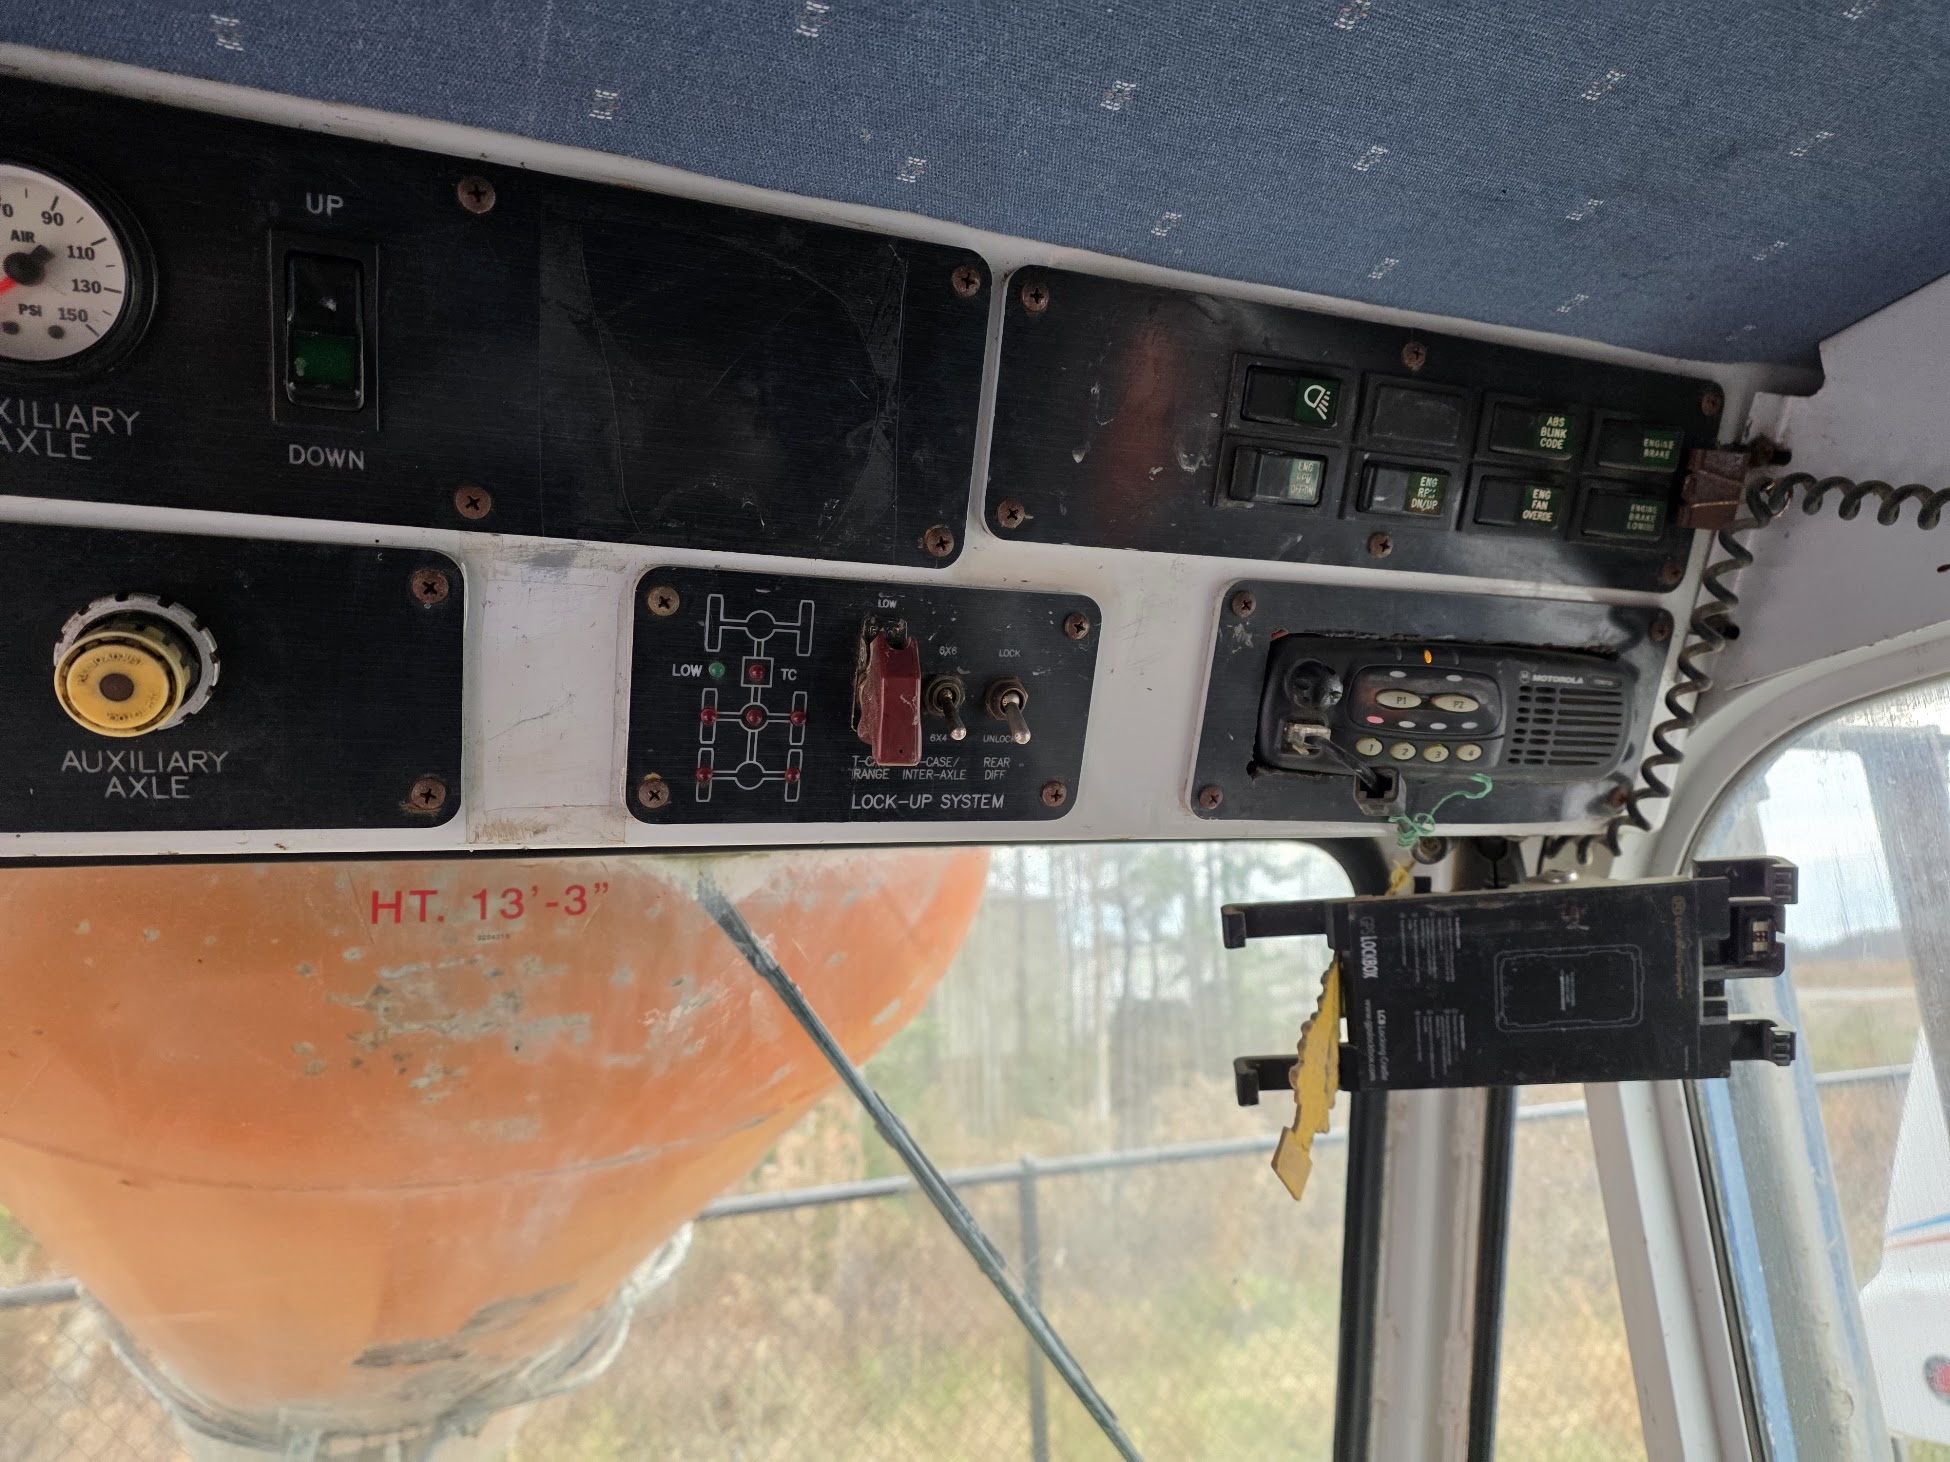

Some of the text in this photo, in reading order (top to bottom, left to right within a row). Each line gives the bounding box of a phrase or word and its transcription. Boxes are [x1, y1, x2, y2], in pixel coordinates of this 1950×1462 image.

[0, 202, 14, 218] 0
[305, 192, 344, 216] UP
[41, 210, 64, 227] 90
[10, 229, 36, 244] AIR
[67, 245, 95, 261] 110
[72, 279, 102, 294] 130
[18, 303, 43, 317] PSI
[58, 307, 88, 323] 150
[1546, 416, 1565, 427] ABS
[1540, 427, 1567, 439] BLINK
[1539, 438, 1564, 450] CODE
[1643, 437, 1675, 450] ENGINE
[288, 444, 365, 471] DOWN
[1643, 448, 1671, 460] BRAKE
[1298, 461, 1314, 472] ENG
[1420, 476, 1438, 488] ENG
[1532, 488, 1552, 500] ENG
[1531, 499, 1549, 511] FAN
[877, 599, 898, 609] LOW
[939, 646, 958, 656] 6X6
[999, 648, 1021, 658] LOCK
[672, 663, 703, 678] LOW
[781, 667, 798, 681] TC
[1531, 674, 1584, 685] MOTOROLA
[1396, 695, 1465, 710] P1 P2
[929, 733, 948, 743] 6X4
[1402, 748, 1409, 756] 2
[1435, 750, 1442, 759] 3
[1467, 748, 1475, 757] 4
[61, 750, 229, 773] AUXILIARY
[852, 755, 876, 767] T-C
[920, 756, 960, 768] -CASE/
[983, 757, 1011, 768] REAR
[852, 768, 890, 780] RANGE
[902, 769, 967, 780] INTER-AXLE
[984, 769, 1007, 781] DIFF
[105, 776, 191, 799] AXLE
[851, 793, 1005, 810] LOCK-UP SYSTEM
[370, 889, 445, 925] HT.
[1360, 936, 1379, 979] LOCKBOX
